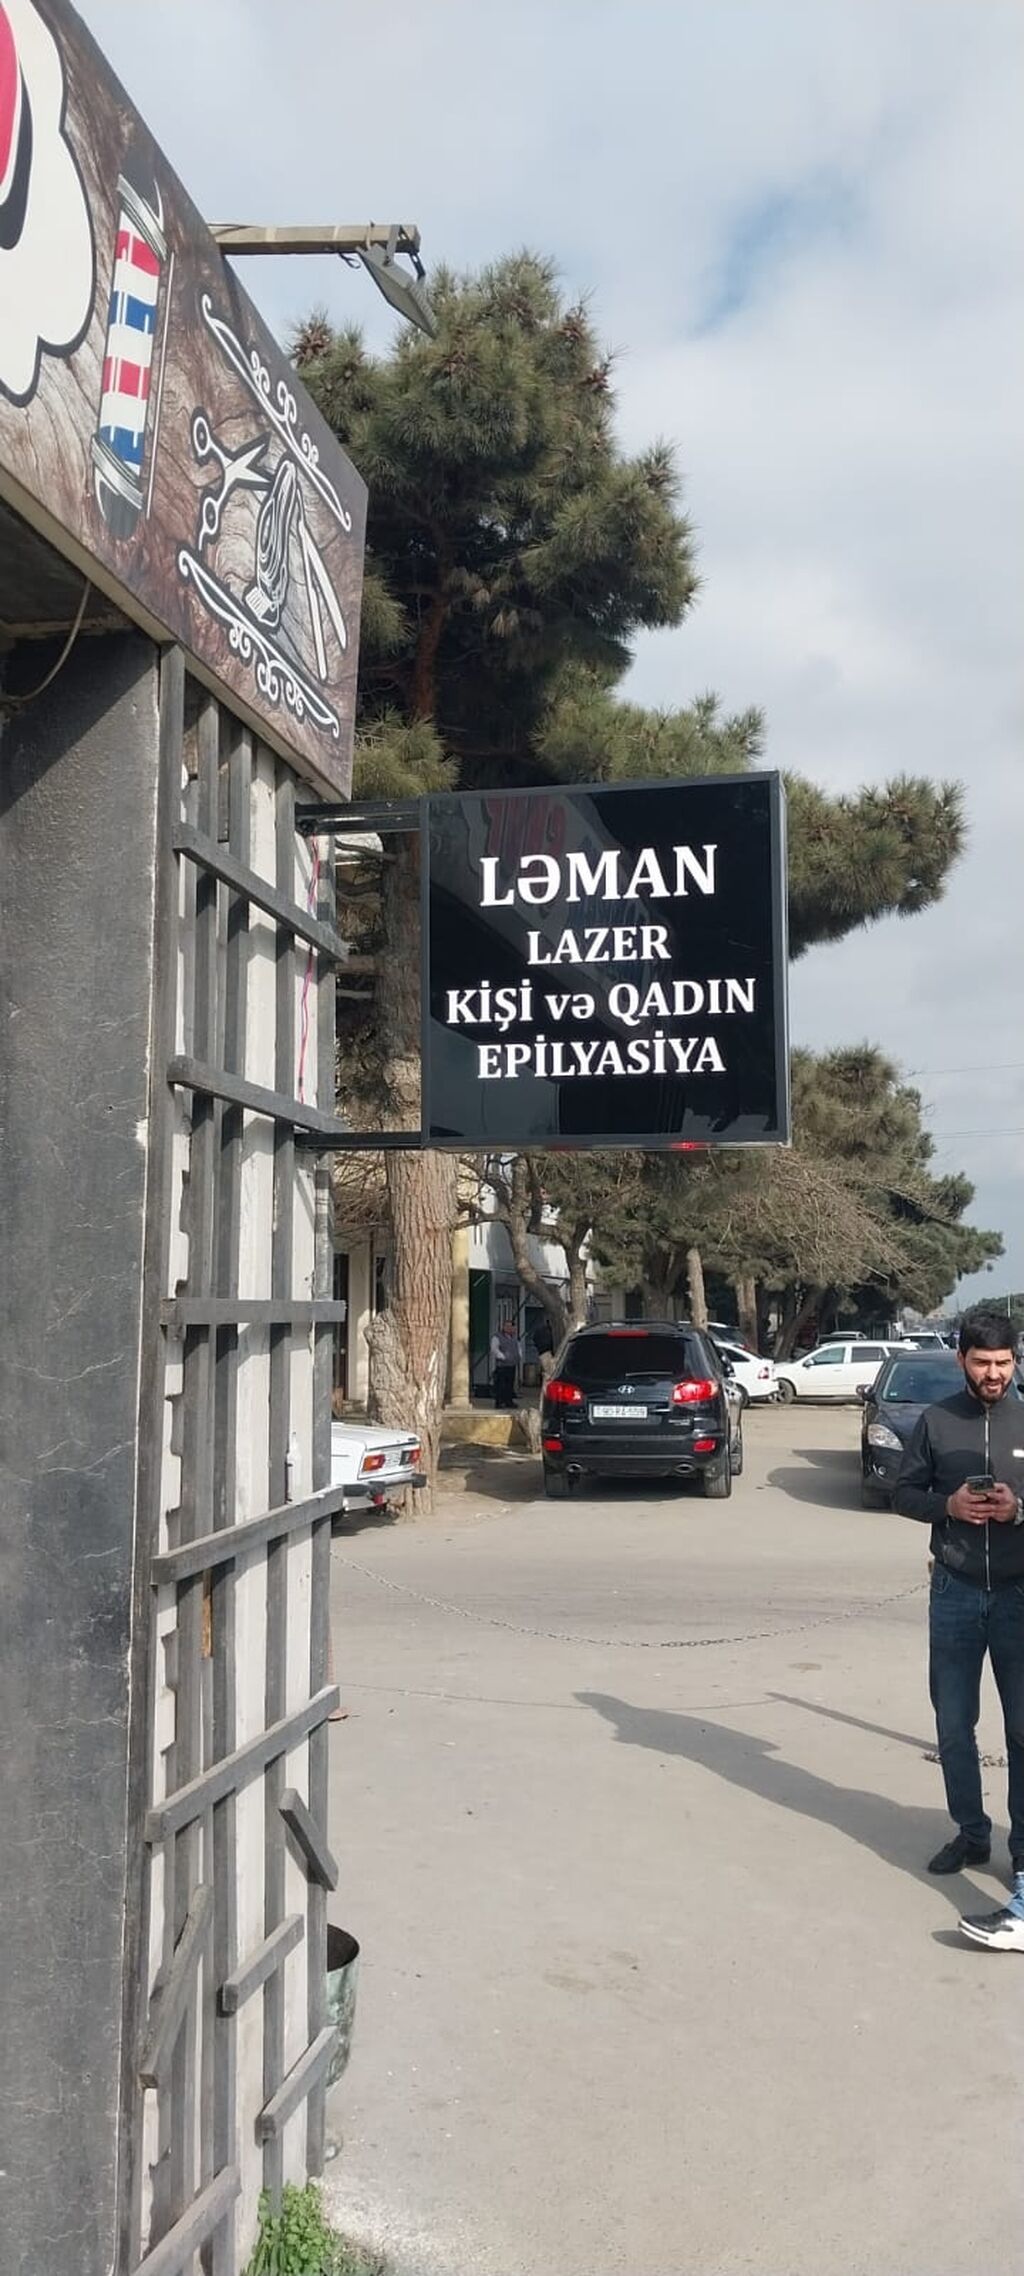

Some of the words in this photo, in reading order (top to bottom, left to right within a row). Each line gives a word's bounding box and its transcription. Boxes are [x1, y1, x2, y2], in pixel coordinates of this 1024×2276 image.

[479, 844, 718, 907] LƏMAN
[527, 925, 672, 965] LAZER
[446, 978, 533, 1032] KİŞİ
[544, 993, 596, 1021] və
[607, 977, 757, 1027] QADIN
[477, 1029, 727, 1079] EPİLYASİYA
